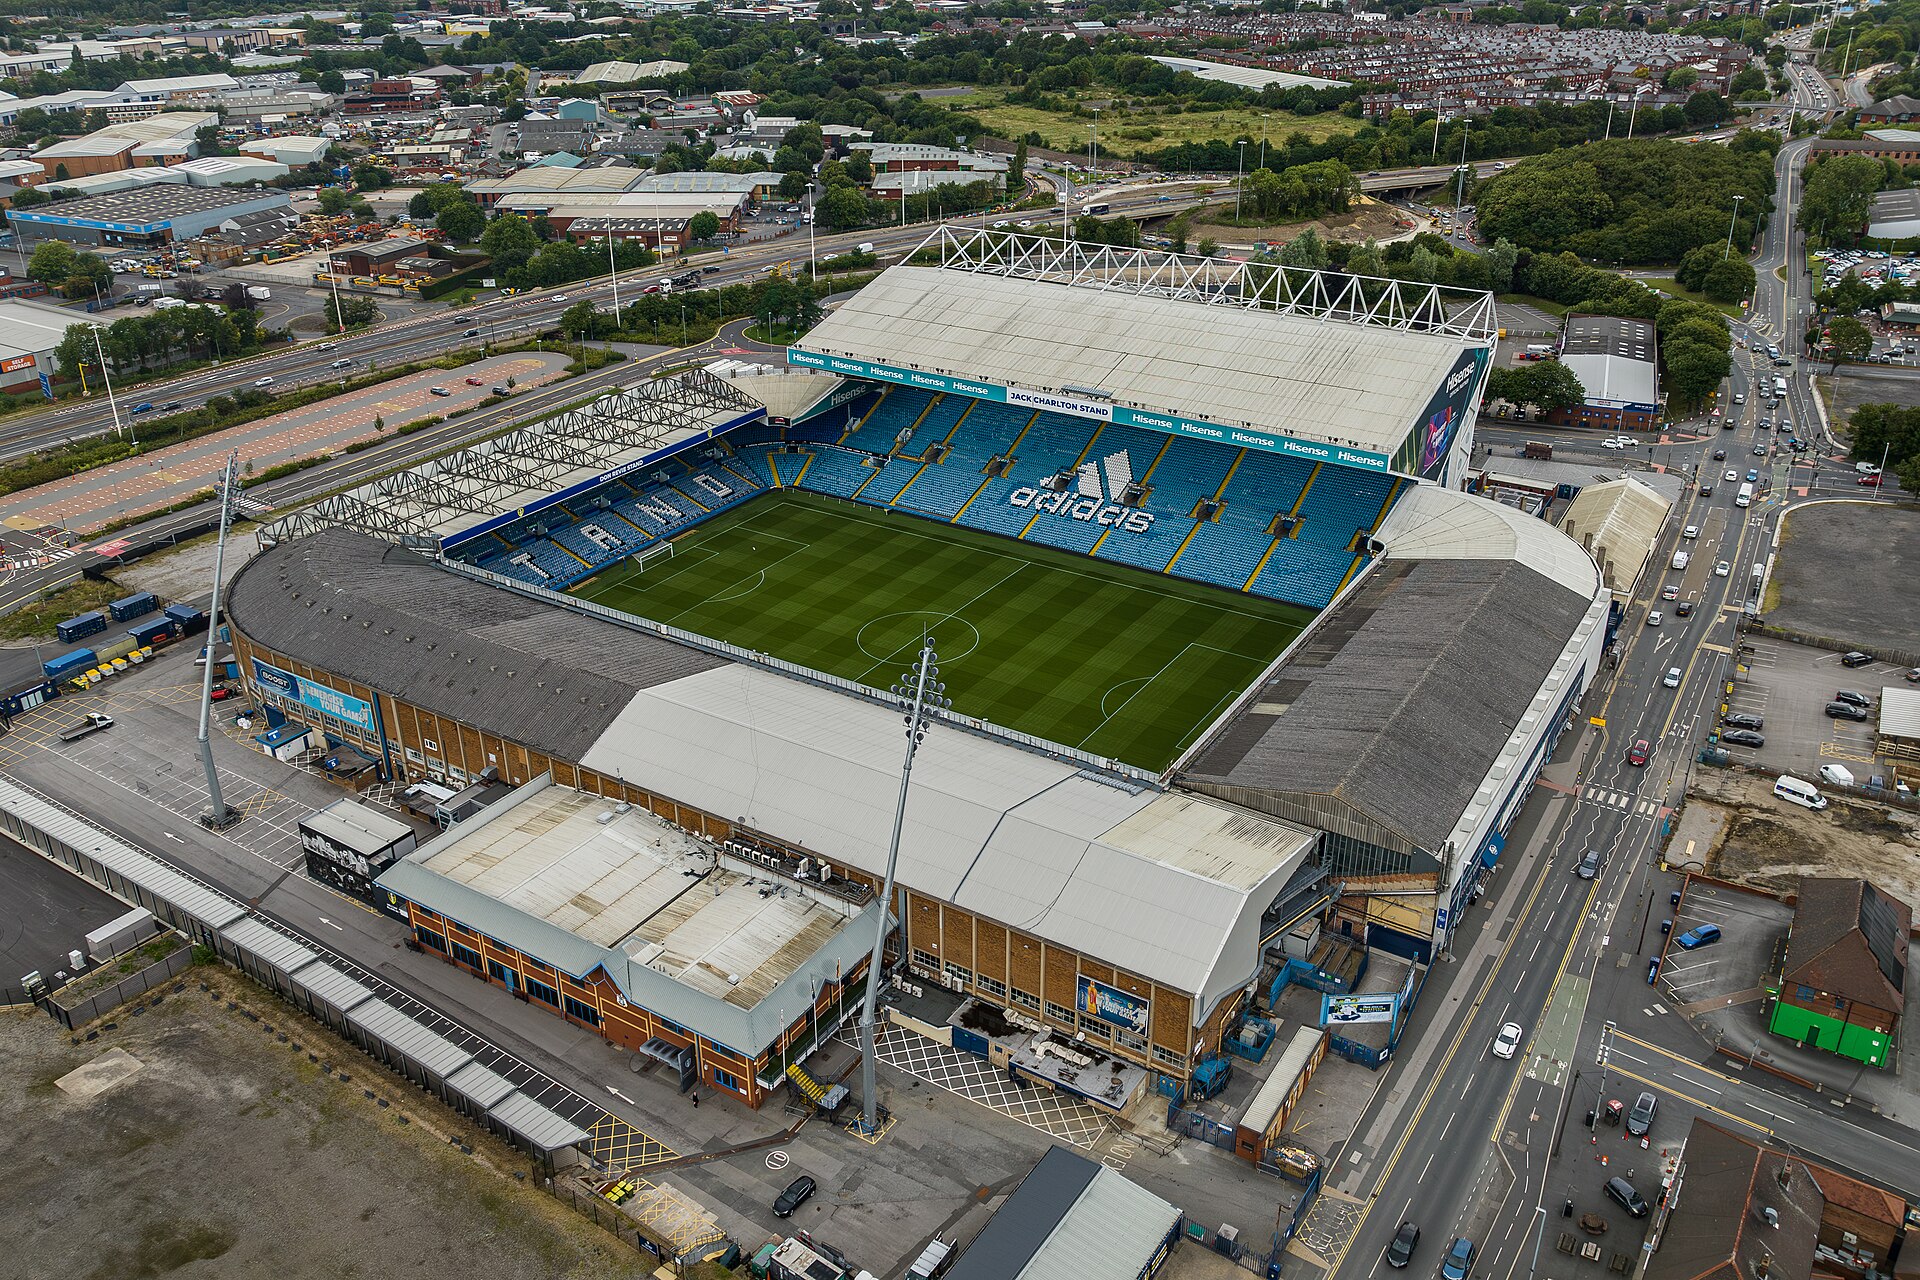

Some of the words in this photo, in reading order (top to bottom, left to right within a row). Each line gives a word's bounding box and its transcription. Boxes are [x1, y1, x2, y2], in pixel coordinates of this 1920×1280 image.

[7, 362, 32, 371] STORAGE
[792, 353, 825, 366] Hisense
[831, 359, 864, 373] Hisense
[870, 366, 904, 380] Hisense
[910, 373, 946, 388] Hisense
[952, 380, 989, 396] Hisense
[1445, 361, 1475, 394] Hisense
[830, 383, 867, 407] Hisense
[1010, 391, 1033, 403] JACK
[1033, 395, 1078, 412] CHARLTON
[1079, 403, 1109, 417] STAND
[1132, 413, 1173, 429] Hisense
[1181, 422, 1223, 438] Hisense
[1231, 431, 1275, 448] Hisense
[1283, 441, 1329, 458] Hisense
[1337, 451, 1385, 468] Hisense
[599, 472, 612, 483] DON
[612, 466, 627, 479] REVIE
[627, 460, 644, 472] STAND
[1010, 486, 1155, 534] adidas
[262, 670, 289, 687] BOOST
[320, 700, 341, 715] YOUR
